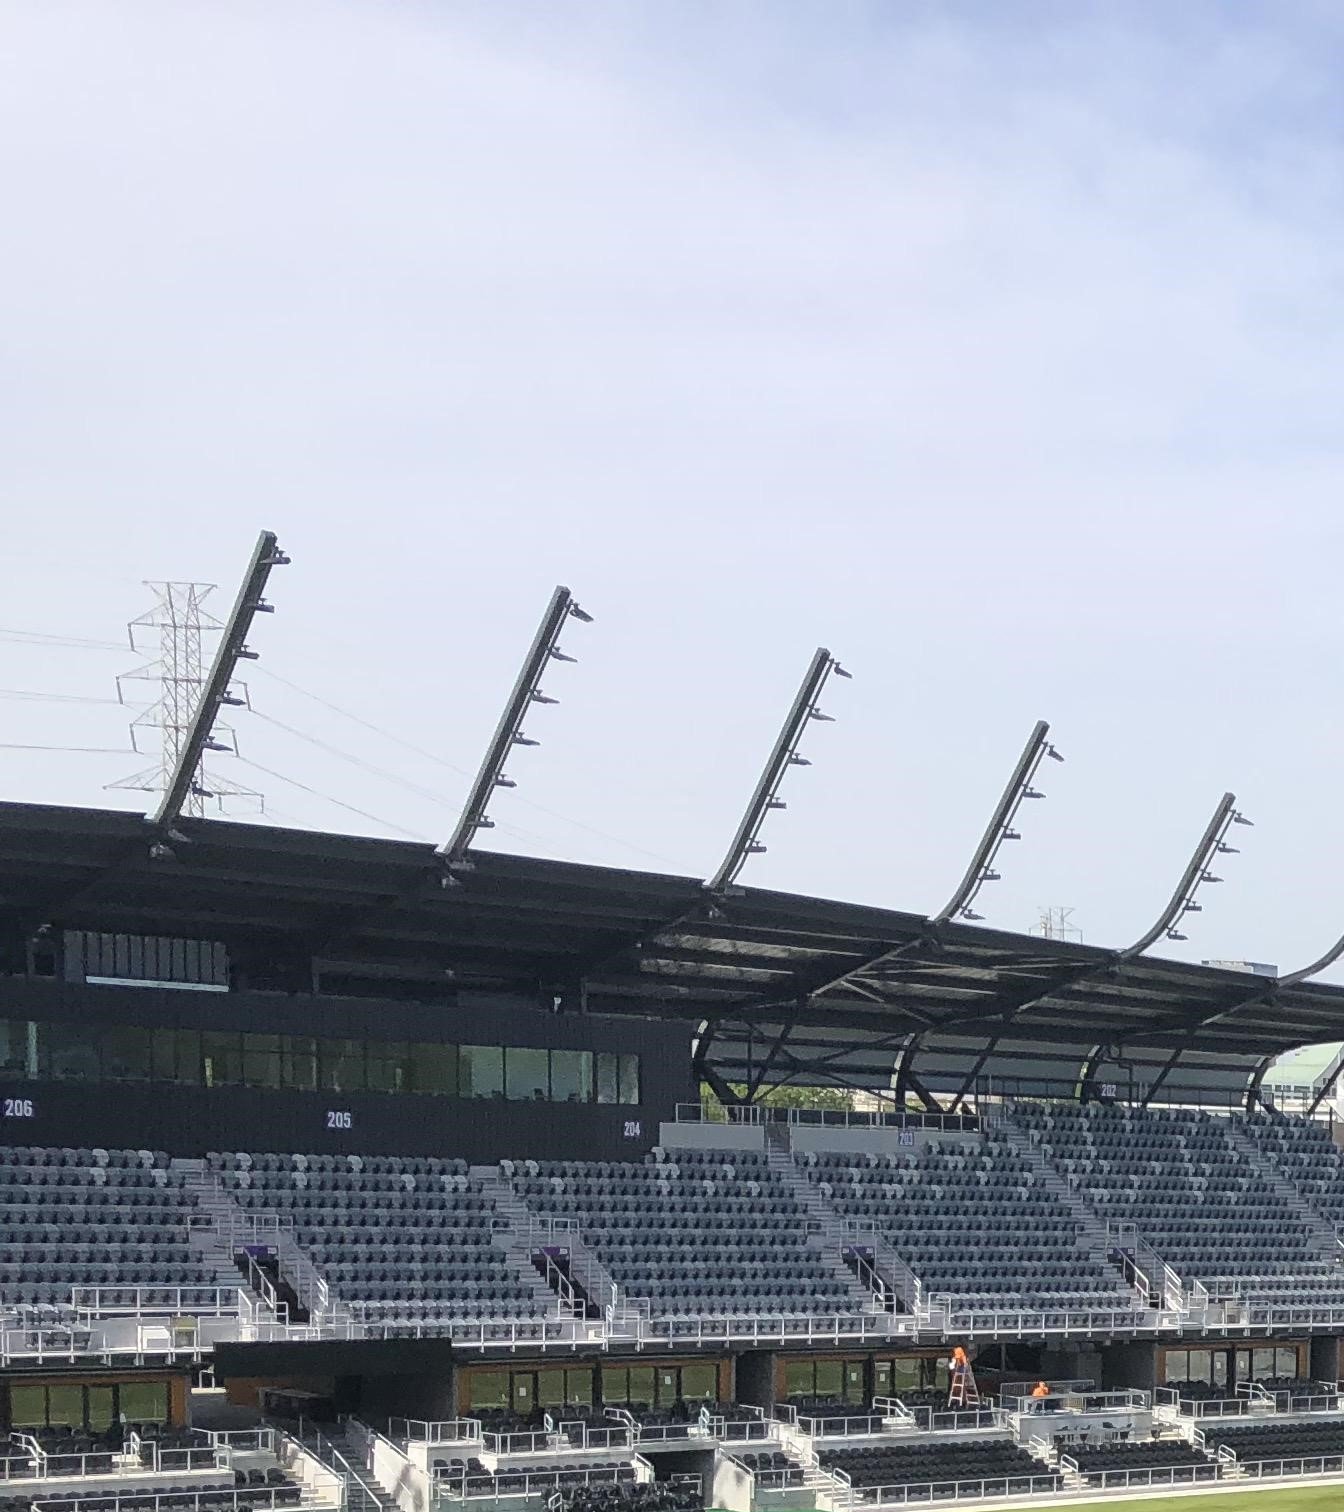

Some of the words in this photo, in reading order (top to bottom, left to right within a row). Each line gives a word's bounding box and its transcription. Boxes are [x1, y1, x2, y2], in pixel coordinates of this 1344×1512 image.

[4, 1098, 33, 1117] 206
[327, 1111, 352, 1128] 205
[624, 1121, 640, 1137] 204
